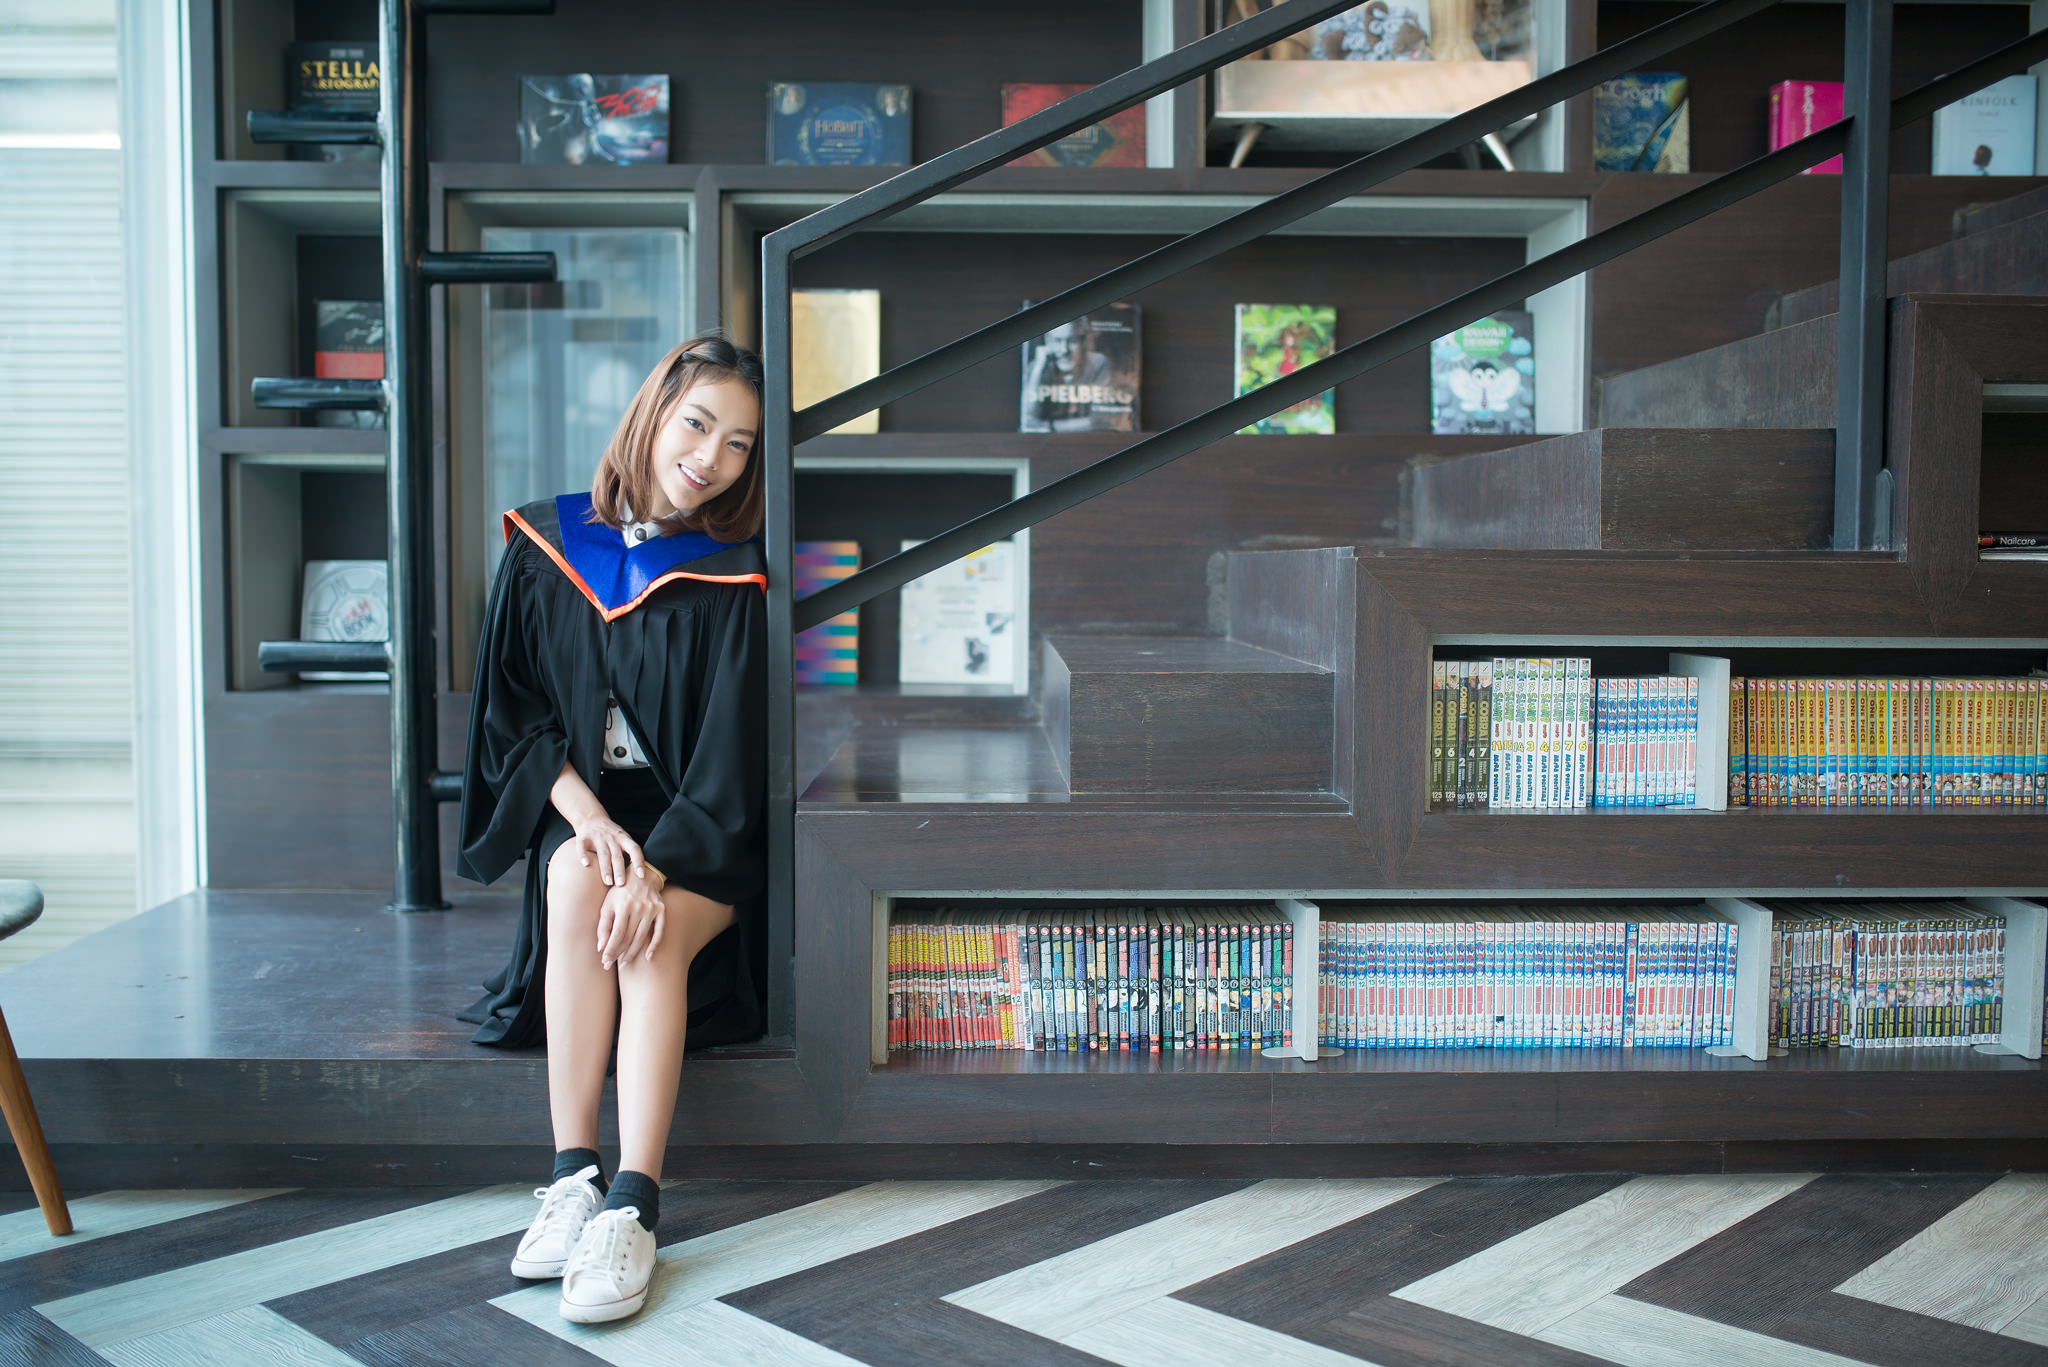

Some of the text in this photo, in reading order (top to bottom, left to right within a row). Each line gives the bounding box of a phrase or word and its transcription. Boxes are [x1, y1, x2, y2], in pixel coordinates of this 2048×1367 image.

[301, 61, 379, 78] STELLA
[1026, 385, 1133, 406] SPIELBERG
[2000, 537, 2036, 545] Nailcare
[1434, 701, 1443, 737] COBRA
[1447, 701, 1457, 737] COBRA
[1480, 701, 1489, 737] COBRA
[1492, 741, 1502, 751] 11
[1503, 741, 1512, 750] 15
[1514, 742, 1524, 752] 14
[1527, 741, 1534, 751] 3
[1540, 742, 1549, 752] 4
[1553, 741, 1560, 751] 5
[1565, 741, 1573, 751] 7
[1579, 741, 1586, 751] 6
[1435, 748, 1442, 757] 9
[1448, 748, 1455, 757] 6
[1469, 748, 1475, 758] 4
[1480, 748, 1487, 757] 7
[1459, 758, 1466, 767] 2
[1858, 970, 1864, 978] 4
[1869, 970, 1875, 978] 7
[1879, 969, 1885, 978] 8
[1919, 968, 1924, 976] 2
[1947, 968, 1953, 976] 9
[1958, 968, 1963, 976] 5
